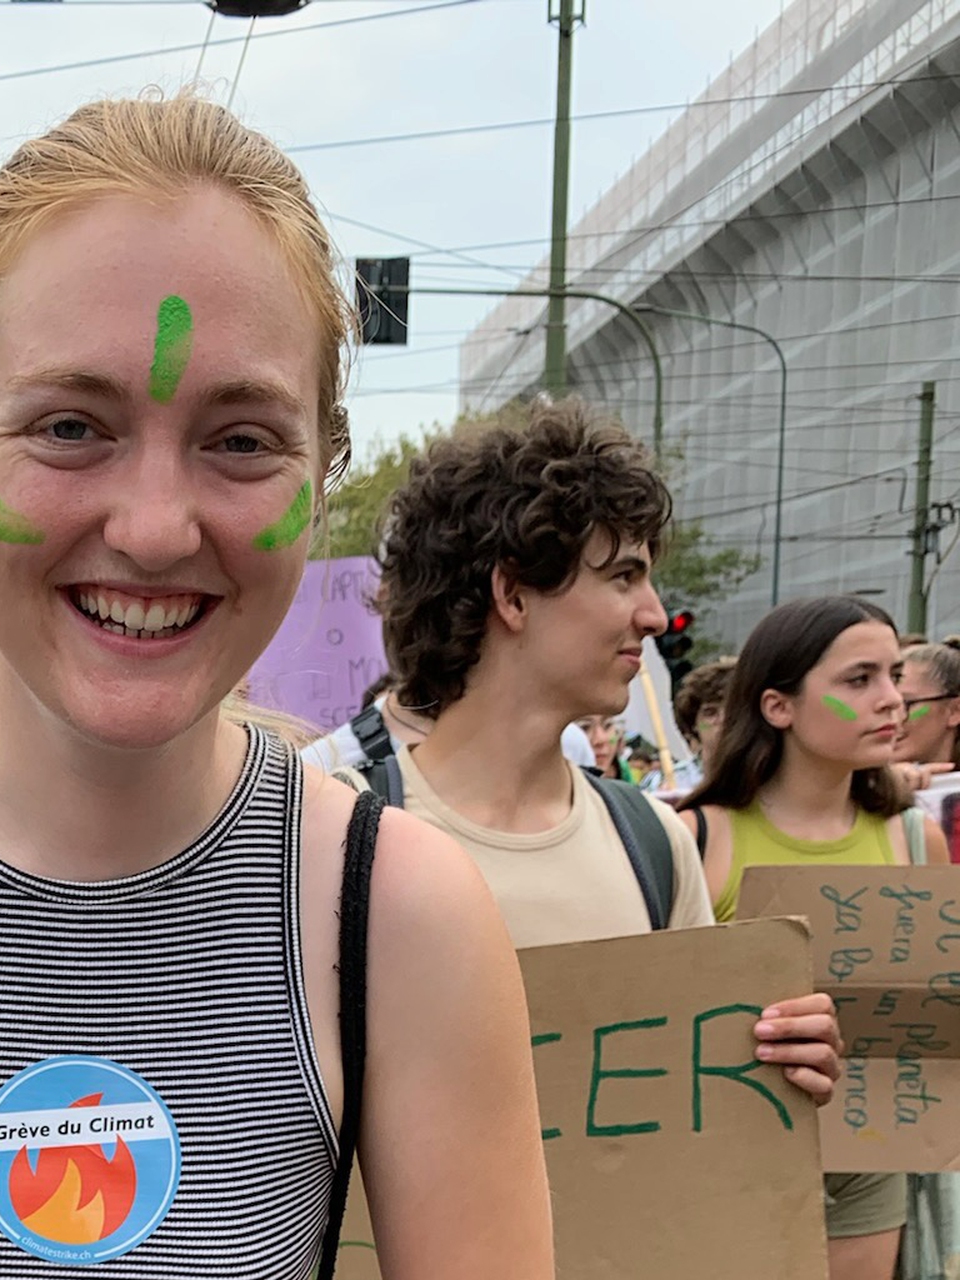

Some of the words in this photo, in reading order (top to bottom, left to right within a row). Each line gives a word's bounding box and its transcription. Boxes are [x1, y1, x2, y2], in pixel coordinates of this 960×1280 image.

[879, 885, 933, 964] fuera
[873, 989, 904, 1016] un
[890, 1023, 951, 1130] planeta
[57, 1119, 82, 1136] du
[89, 1114, 155, 1133] Climat
[20, 1235, 92, 1261] climatestrike.ch
